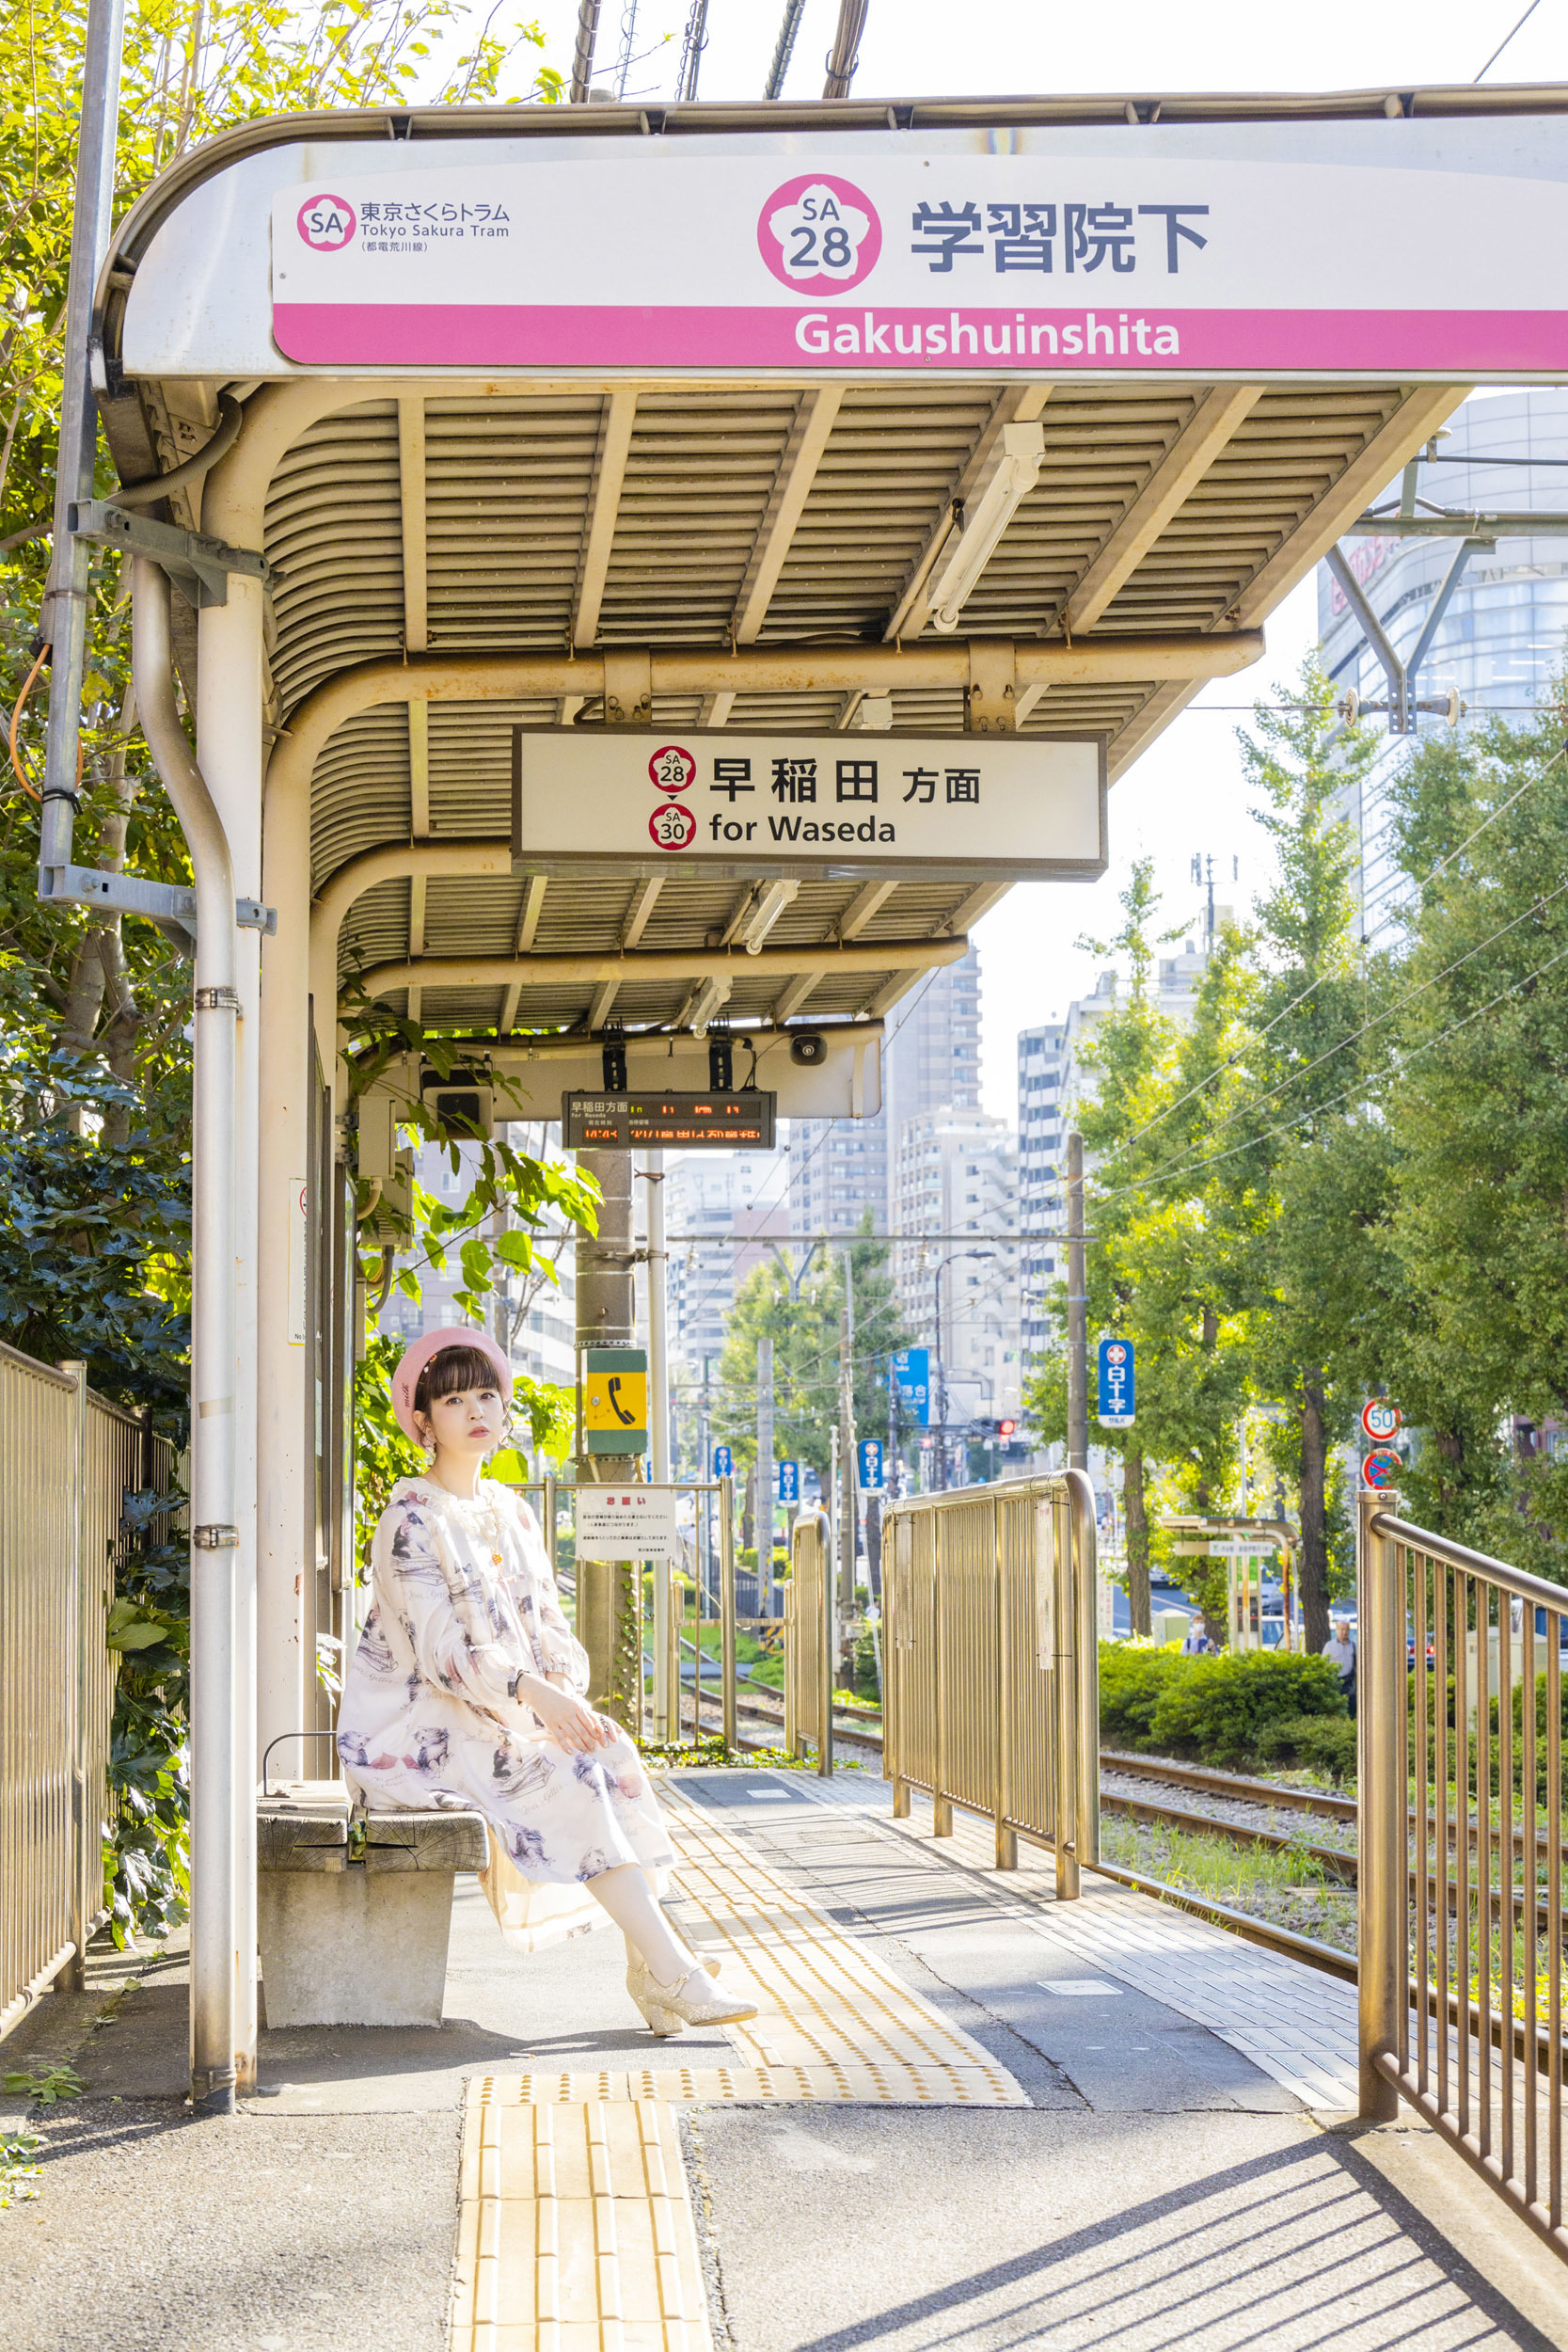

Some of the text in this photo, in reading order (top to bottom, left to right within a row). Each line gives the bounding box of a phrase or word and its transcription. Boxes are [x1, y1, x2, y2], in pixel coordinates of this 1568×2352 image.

[360, 202, 510, 221] 東京さくらトラム
[803, 197, 840, 221] SA
[310, 212, 344, 233] SA
[360, 224, 509, 239] Tokyo Sakura Tram
[789, 226, 852, 268] 28
[911, 201, 1210, 274] 学習院下
[795, 312, 1180, 356] Gakushuinshita
[665, 755, 681, 765] SA
[660, 765, 685, 783] 28
[665, 812, 681, 822] SA
[660, 822, 685, 841] 30
[709, 814, 895, 843] for Waseda
[572, 1101, 628, 1113] 早稲田方面
[1107, 1365, 1126, 1414] 白十字
[1371, 1409, 1393, 1428] 50
